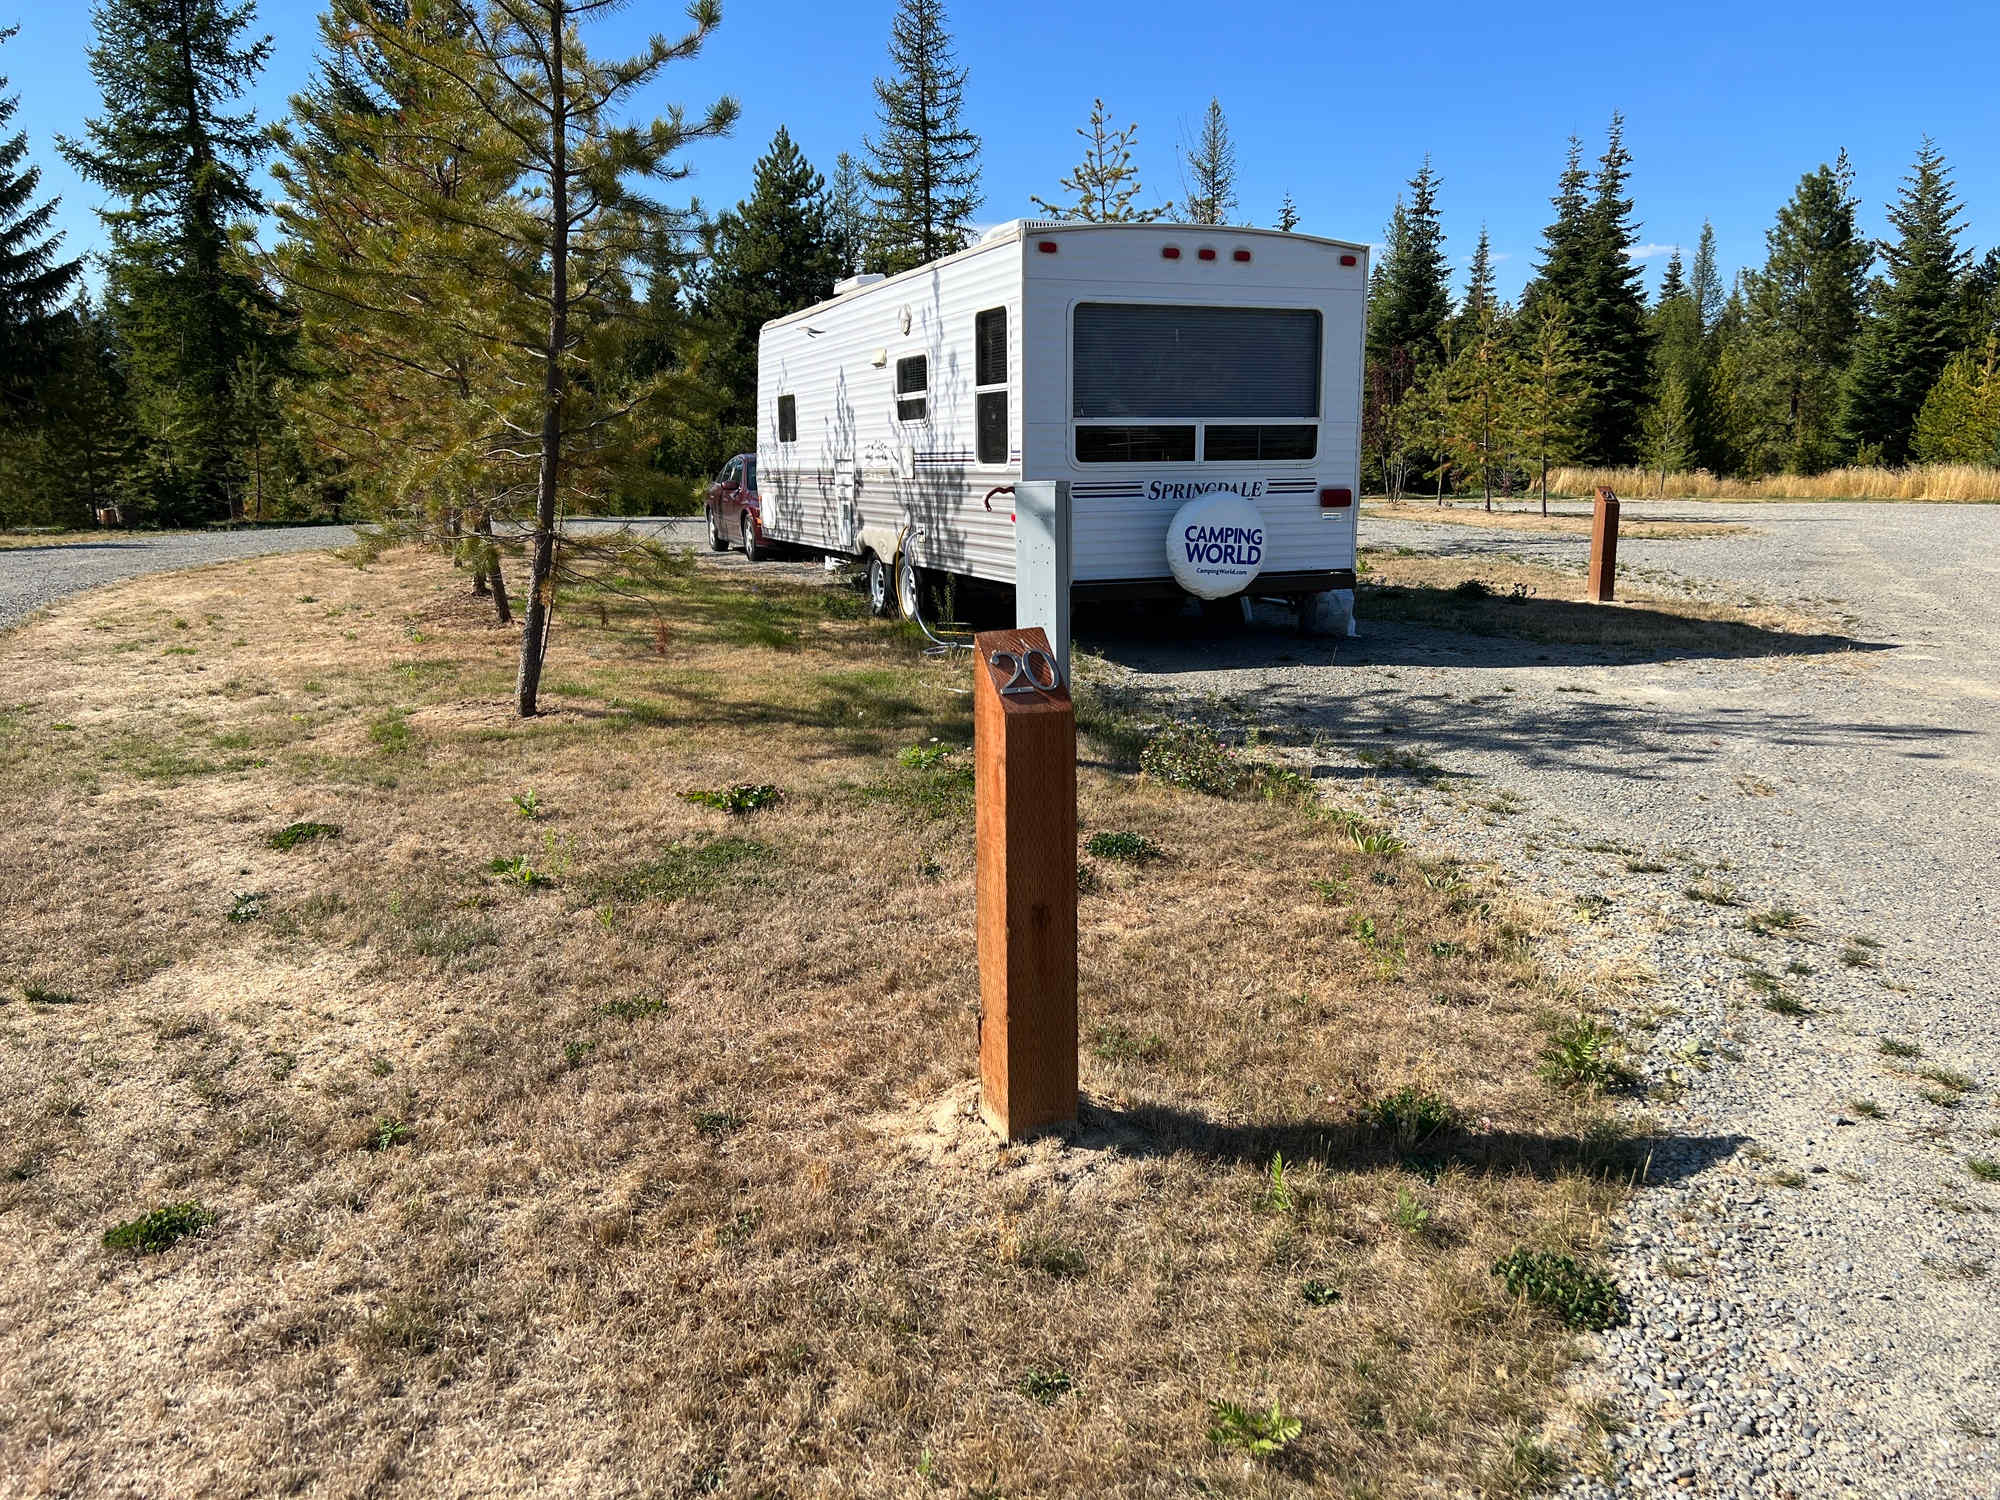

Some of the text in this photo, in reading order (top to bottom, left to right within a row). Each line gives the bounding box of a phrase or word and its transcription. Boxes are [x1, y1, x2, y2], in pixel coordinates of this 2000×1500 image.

[1184, 525, 1263, 546] CAMPING
[1184, 542, 1262, 565] WORLD
[1196, 567, 1248, 576] CampingWorld.com
[988, 647, 1060, 696] 20
